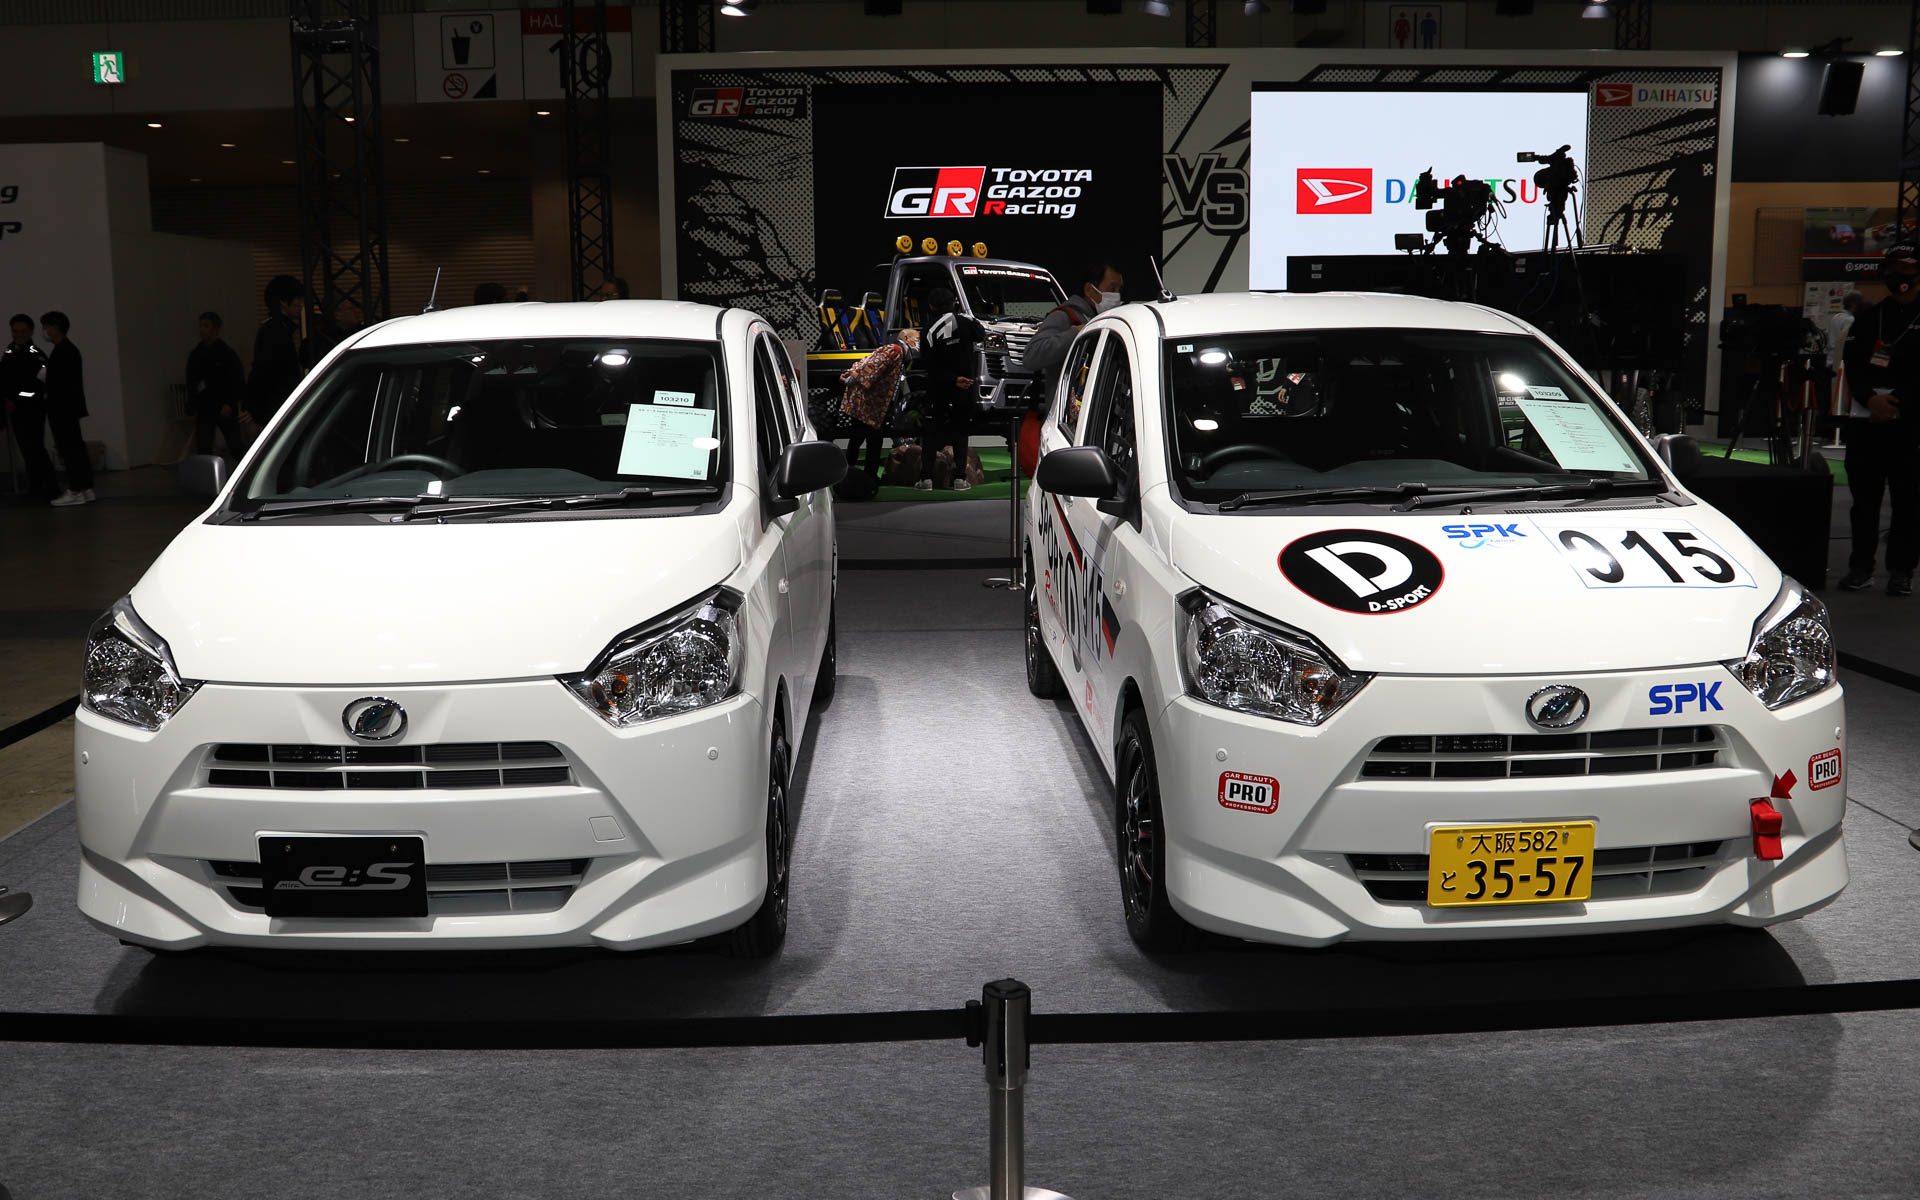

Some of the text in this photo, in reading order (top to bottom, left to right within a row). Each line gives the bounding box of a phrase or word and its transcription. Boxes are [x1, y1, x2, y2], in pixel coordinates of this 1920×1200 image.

[529, 14, 564, 28] HAL
[549, 38, 612, 91] 10
[747, 88, 804, 97] TOYOTA
[1638, 89, 1713, 102] DAIHATSU
[692, 99, 739, 115] GR
[745, 97, 798, 106] GAZOO
[744, 105, 795, 117] Racing
[991, 168, 1093, 183] TOYOTA
[988, 184, 1082, 199] GAZOO
[1161, 153, 1250, 232] VS
[890, 187, 977, 214] GR
[984, 200, 1077, 219] Racing
[1442, 524, 1528, 538] SPK
[1368, 584, 1432, 613] D-SPORT
[1083, 555, 1103, 661] 915
[1649, 681, 1724, 716] SPK
[1816, 759, 1836, 780] PRO
[1243, 775, 1274, 783] BEAUTY
[1229, 782, 1266, 803] PRO
[1225, 802, 1268, 812] PROFESSIONAL
[1441, 856, 1585, 900] と 35-57
